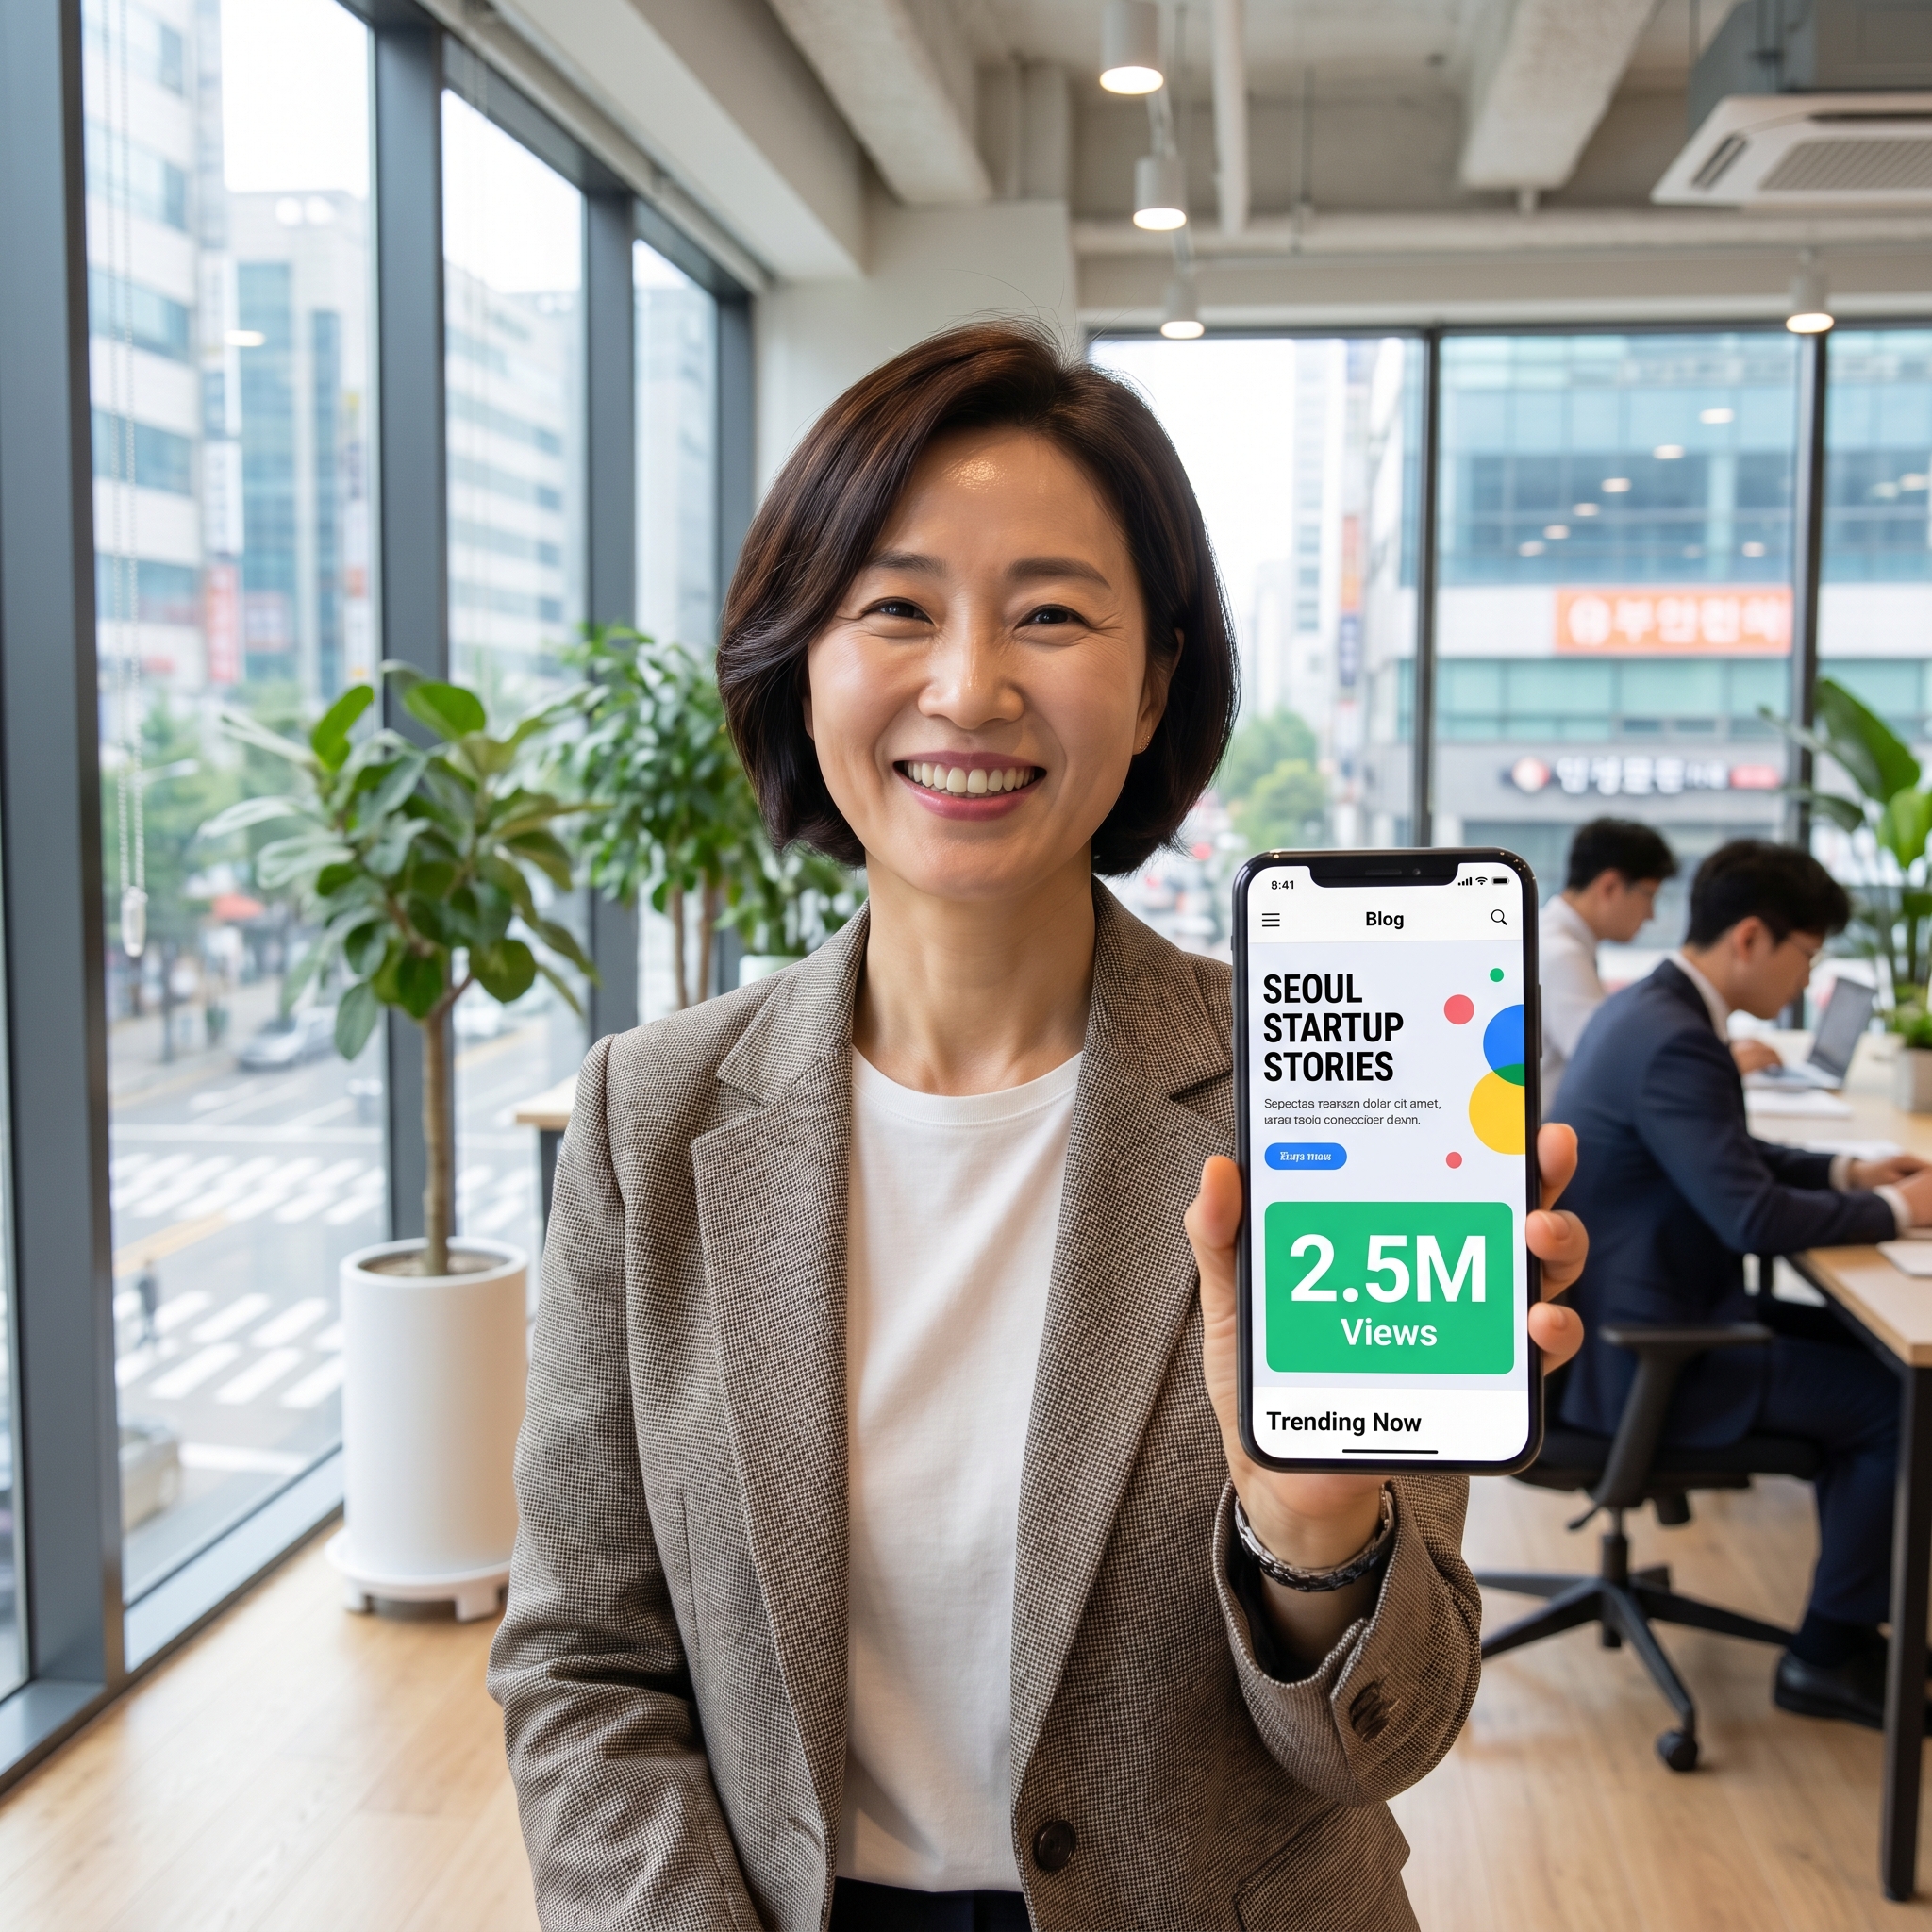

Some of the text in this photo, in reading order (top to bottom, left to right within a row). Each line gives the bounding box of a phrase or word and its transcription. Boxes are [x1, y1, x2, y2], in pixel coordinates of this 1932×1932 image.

[1366, 911, 1405, 929] Blog
[1263, 974, 1362, 1004] SEOUL
[1263, 1012, 1404, 1042] STARTUP
[1264, 1051, 1393, 1082] STORIES
[1264, 1098, 1315, 1110] Sepectas
[1363, 1098, 1391, 1108] dolar
[1394, 1099, 1407, 1108] cit
[1410, 1099, 1441, 1110] amet,
[1290, 1233, 1486, 1303] 2.5M
[1341, 1317, 1438, 1346] Views
[1266, 1411, 1422, 1436] Trending Now
